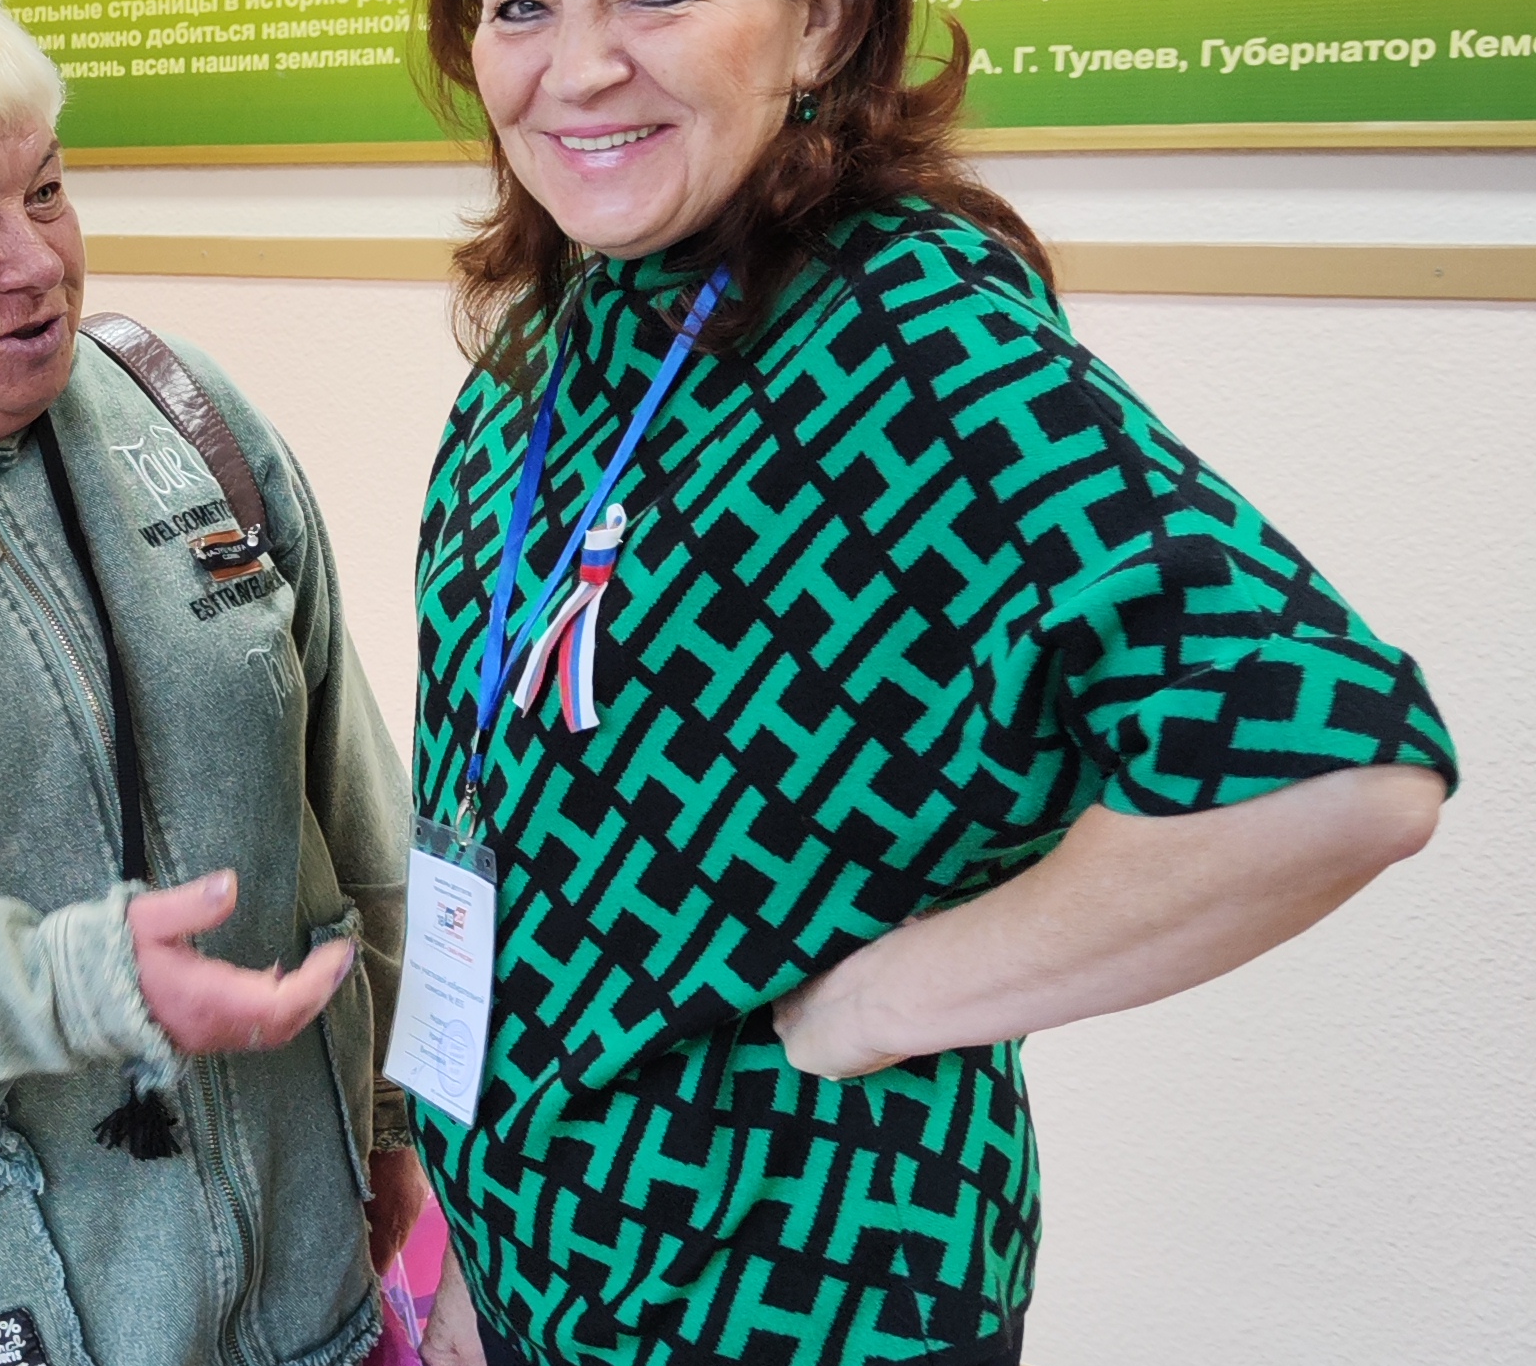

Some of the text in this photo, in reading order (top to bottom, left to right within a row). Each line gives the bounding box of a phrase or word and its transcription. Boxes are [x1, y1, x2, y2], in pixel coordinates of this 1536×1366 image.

[70, 28, 142, 50] можно
[146, 21, 256, 49] добиться
[260, 8, 410, 41] намеченной
[60, 45, 402, 79] жизнь всем нашим землякам.
[968, 28, 1536, 79] А. Г. Тулеев, Губернатор Кем
